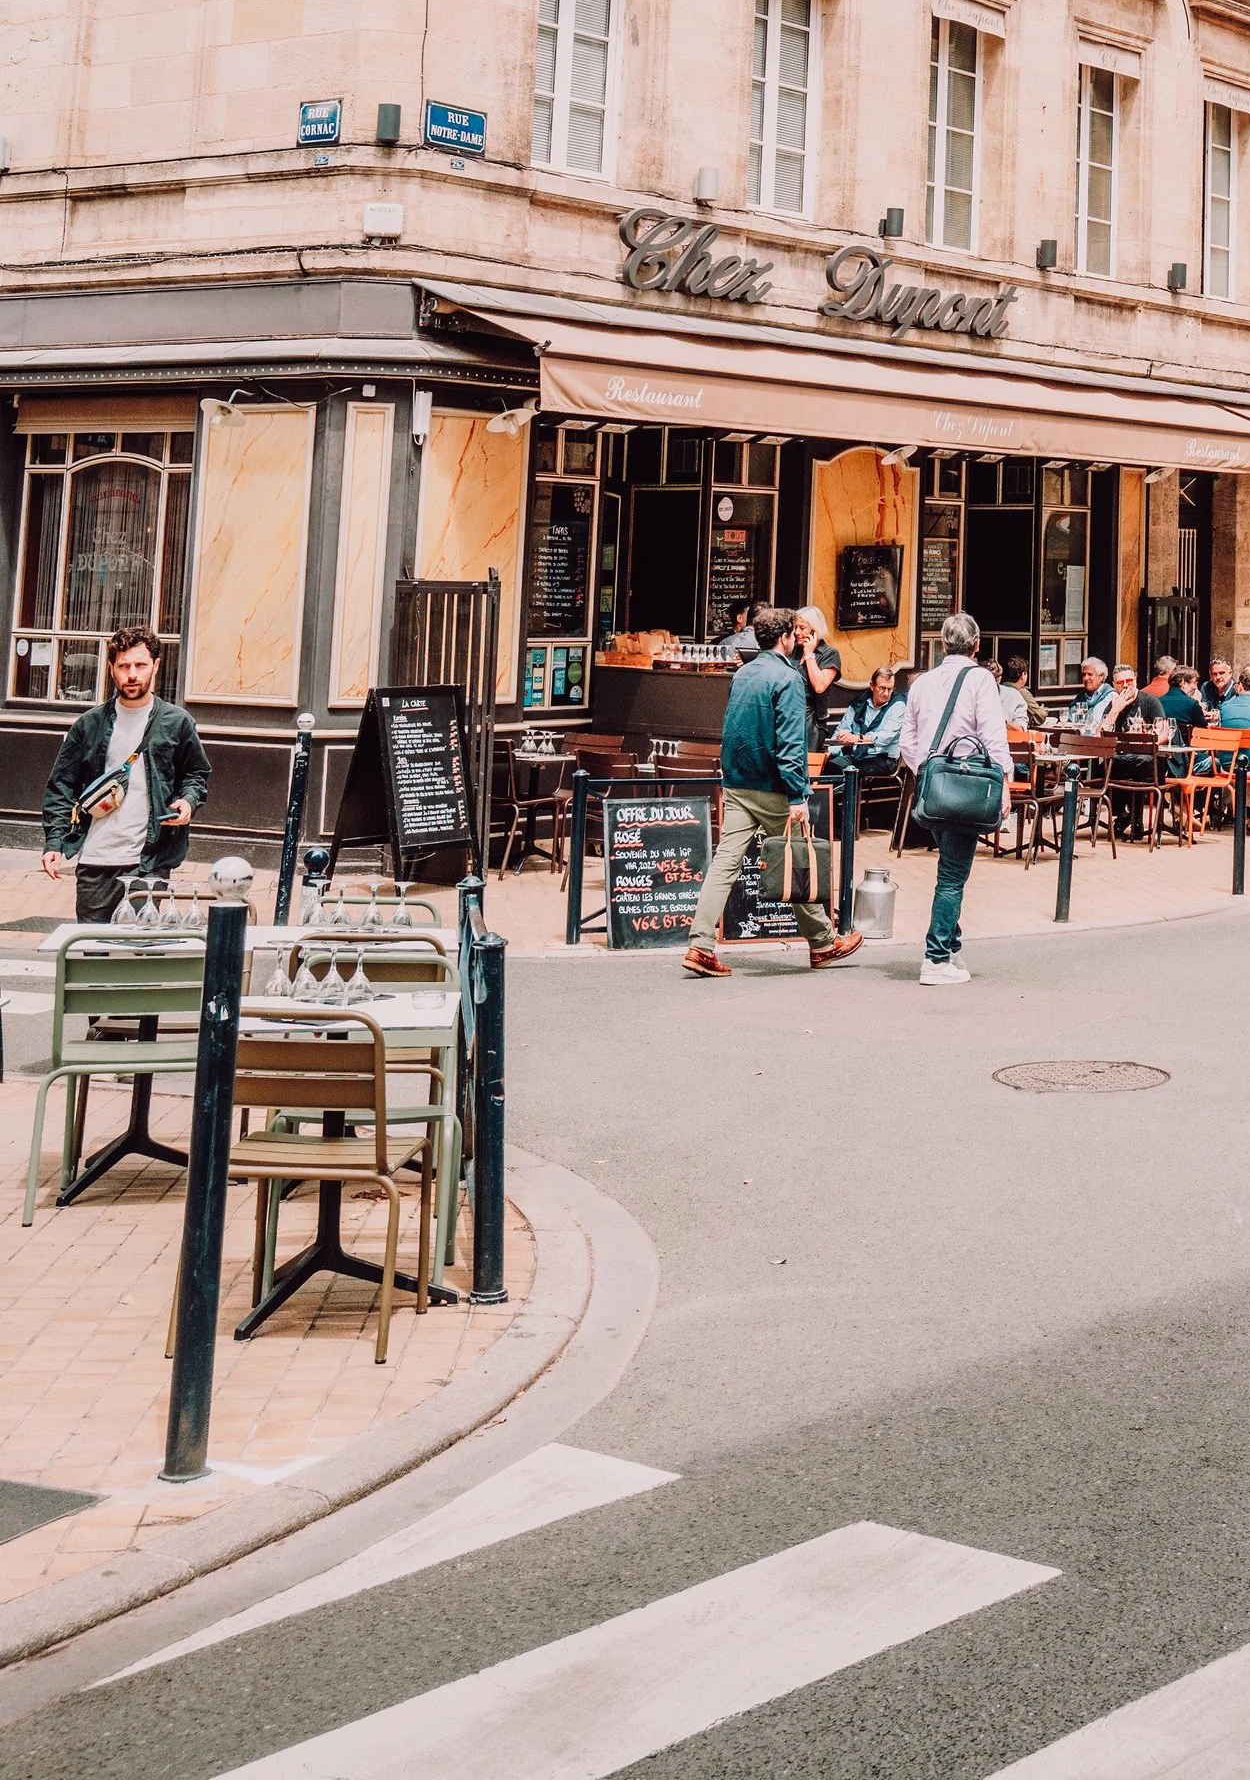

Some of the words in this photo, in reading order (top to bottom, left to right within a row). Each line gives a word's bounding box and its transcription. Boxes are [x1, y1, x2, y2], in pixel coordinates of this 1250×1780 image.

[308, 107, 329, 119] RUE
[447, 111, 470, 127] RUE
[300, 122, 336, 136] CORNAC
[430, 123, 484, 146] NOTRE-DAME
[618, 207, 775, 304] Chez
[817, 245, 1020, 338] Dupont
[604, 376, 705, 409] Restaurant
[932, 409, 964, 442] Chez
[966, 413, 1015, 443] Dupont
[1184, 438, 1241, 461] Restaurant
[549, 524, 569, 536] TAPAS
[402, 699, 410, 708] LA
[410, 699, 427, 708] CARTE
[616, 806, 649, 821] OFFRE
[649, 807, 664, 821] DU
[664, 805, 695, 821] JOUR
[614, 828, 642, 844] ROSÉ
[615, 849, 648, 860] SOUVENIR
[650, 849, 660, 859] DU
[662, 848, 676, 858] VAR
[615, 874, 653, 887] ROUGES
[642, 892, 653, 902] LES
[660, 904, 669, 913] DE
